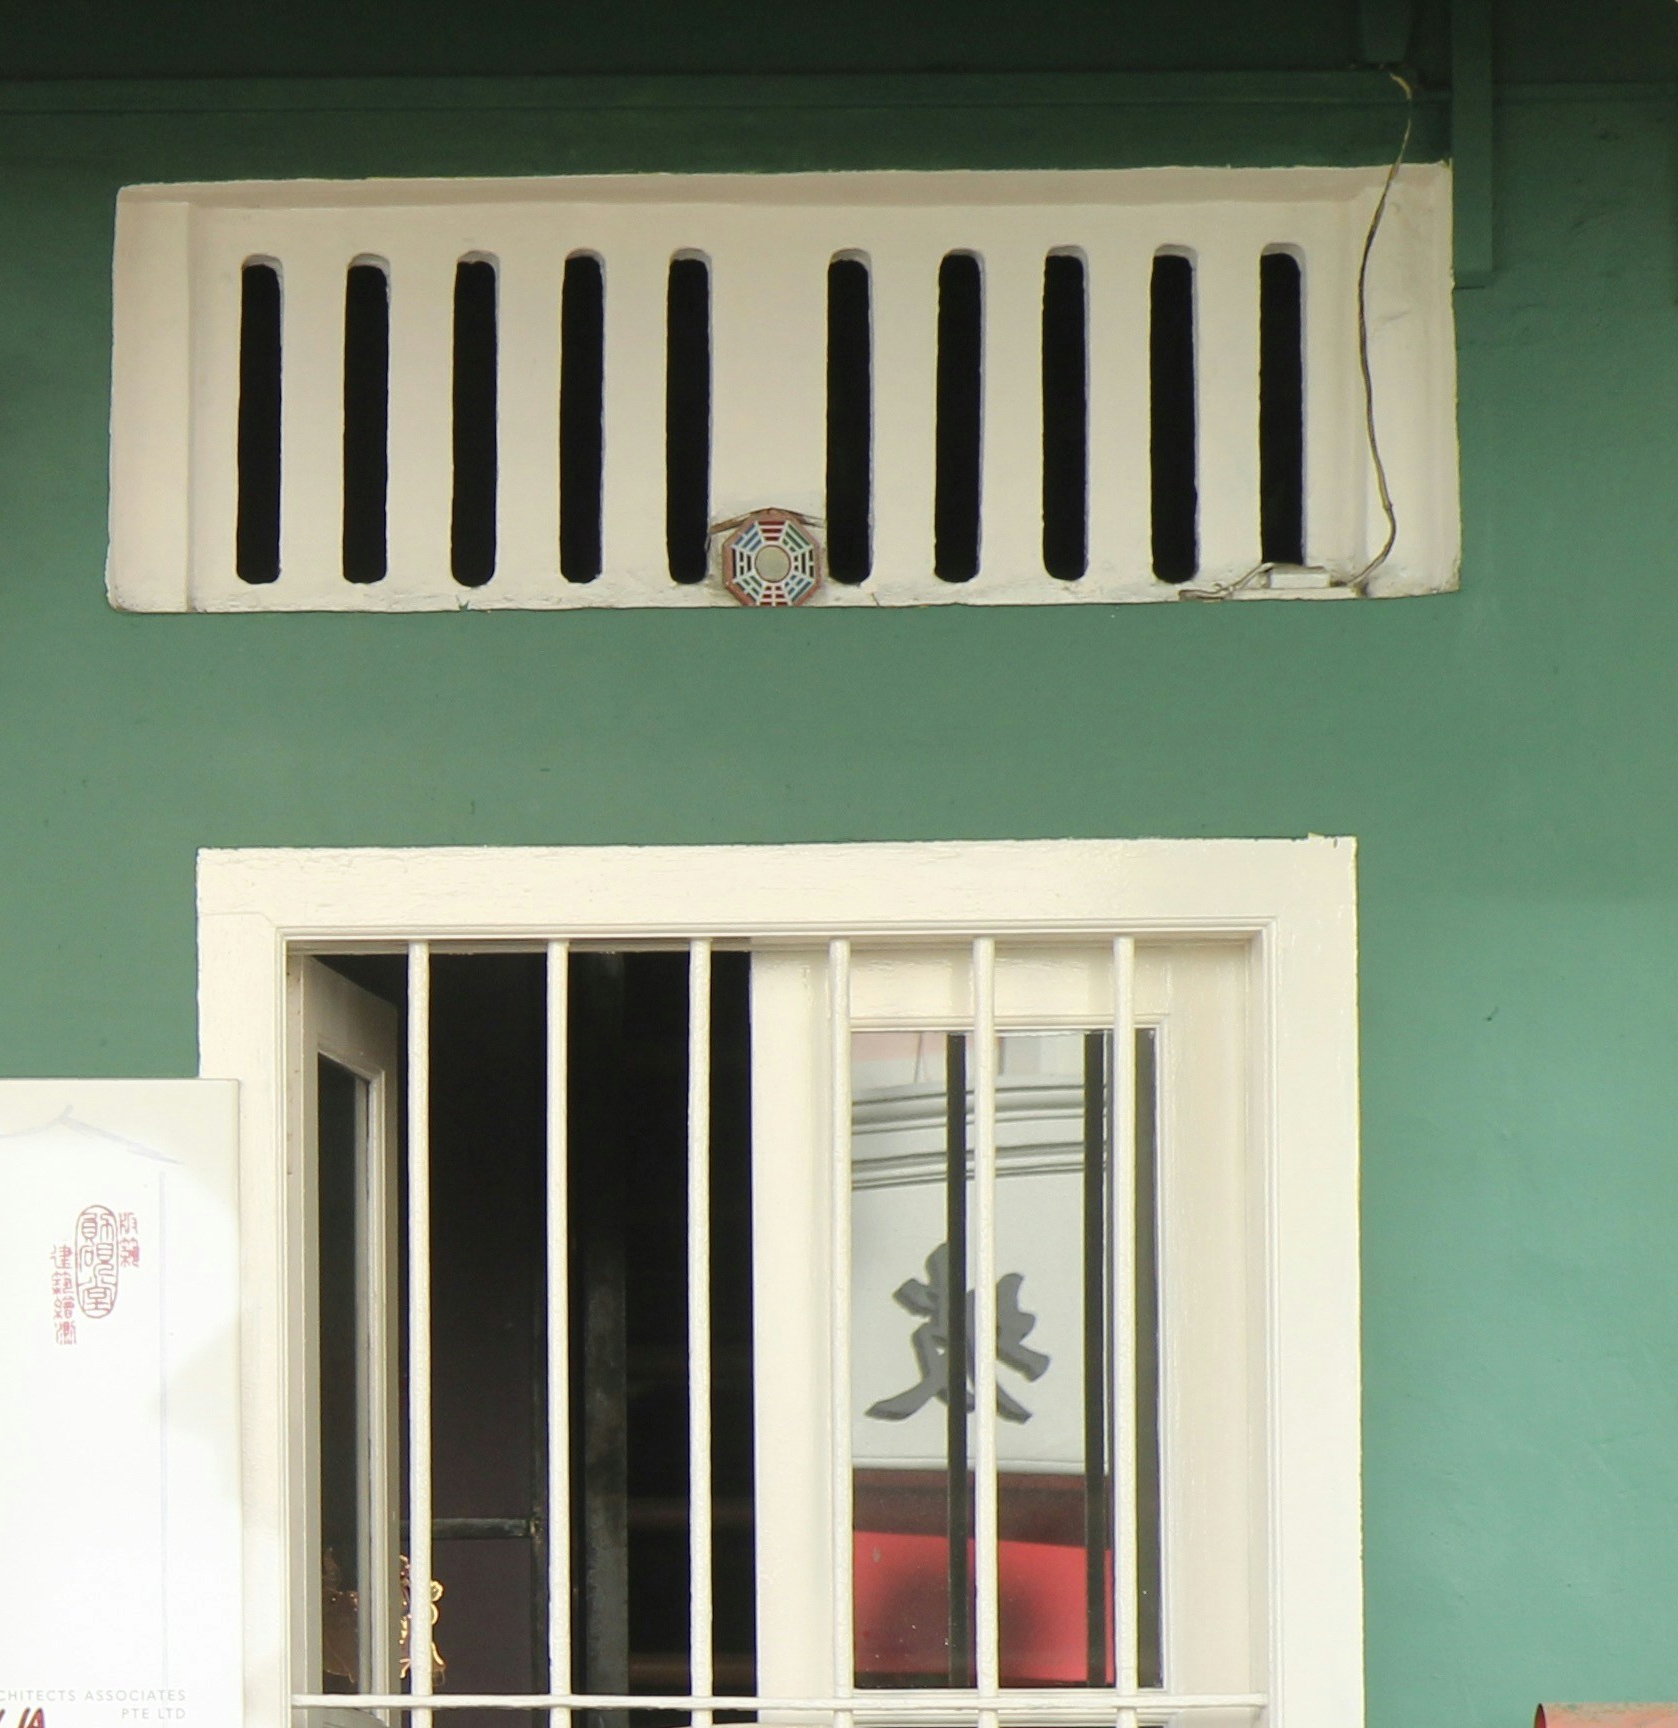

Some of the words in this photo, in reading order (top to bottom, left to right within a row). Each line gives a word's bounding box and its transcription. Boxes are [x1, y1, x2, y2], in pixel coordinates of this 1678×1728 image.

[84, 1689, 187, 1702] ASSOCIATES
[121, 1707, 150, 1720] PTE
[157, 1707, 187, 1720] LTD
